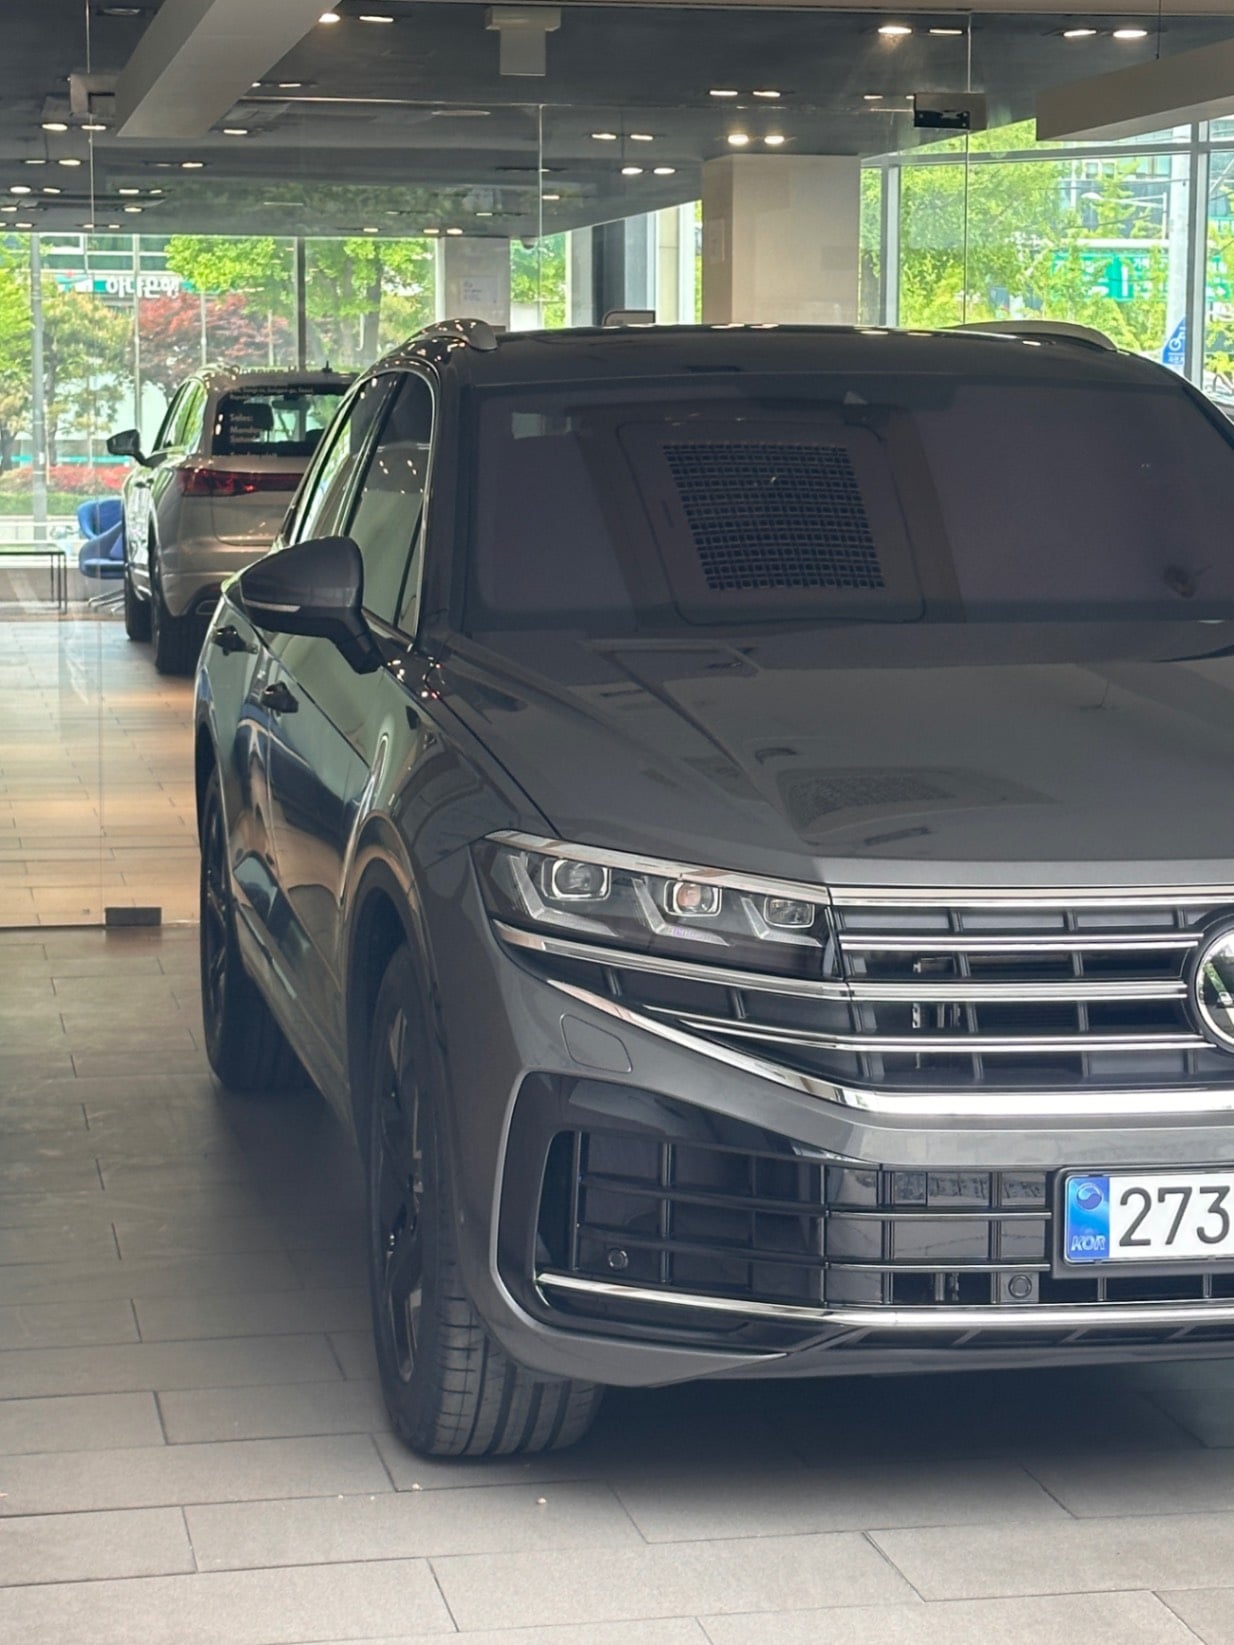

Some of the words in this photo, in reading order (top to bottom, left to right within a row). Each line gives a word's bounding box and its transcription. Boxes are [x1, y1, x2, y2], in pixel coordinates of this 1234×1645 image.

[106, 275, 180, 299] 하나은행
[1119, 1185, 1230, 1247] 273
[1071, 1235, 1106, 1251] KOR
